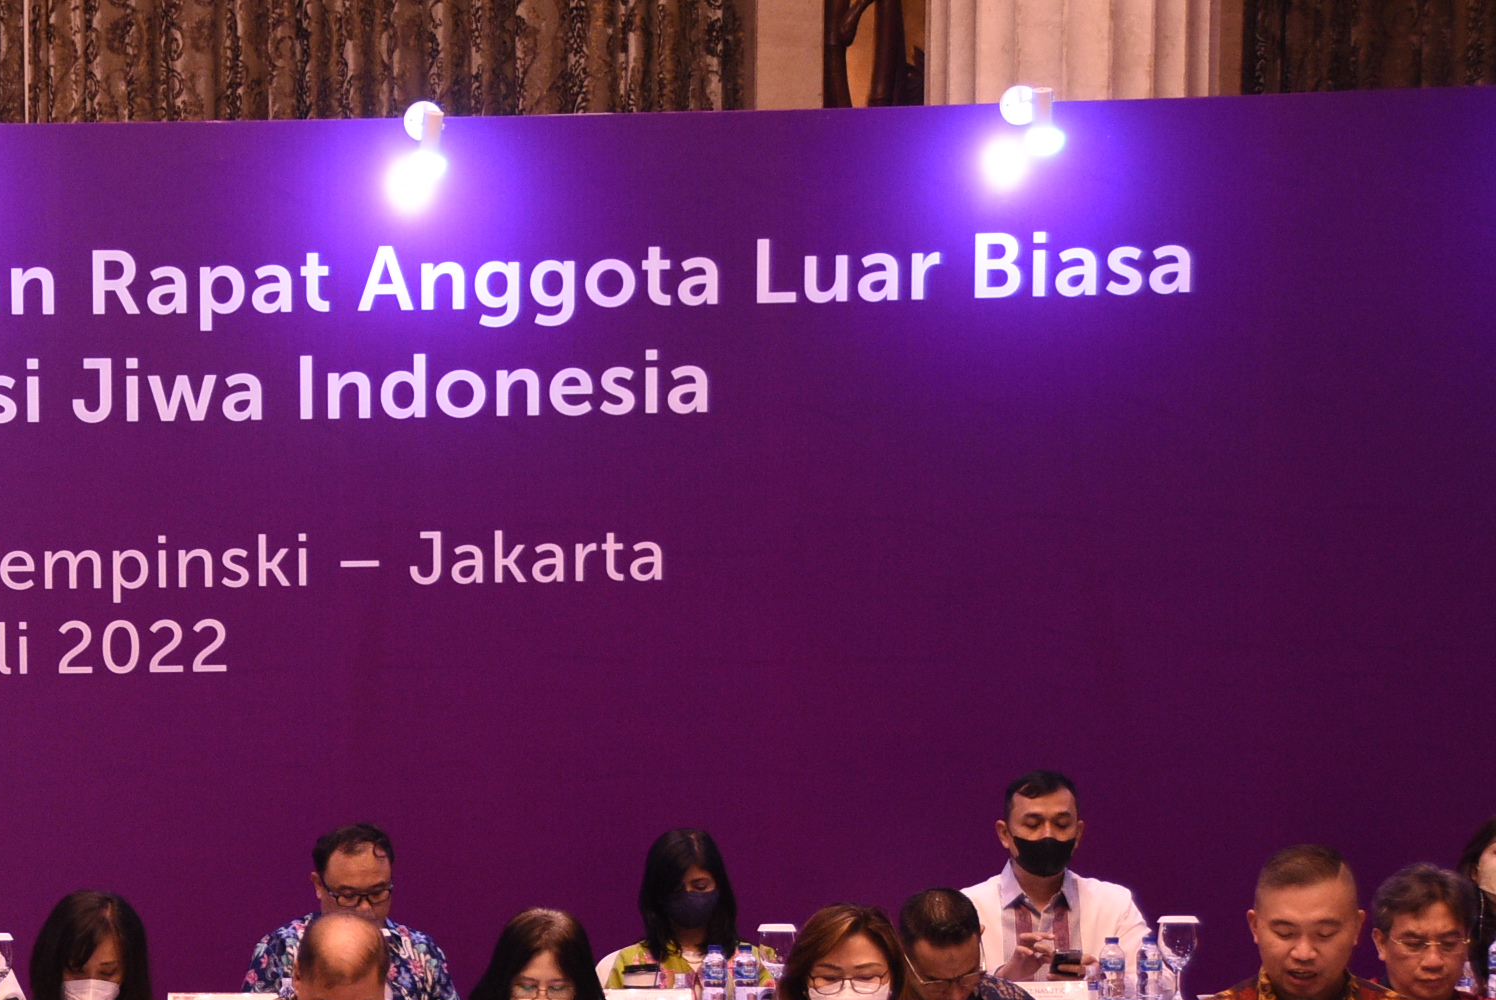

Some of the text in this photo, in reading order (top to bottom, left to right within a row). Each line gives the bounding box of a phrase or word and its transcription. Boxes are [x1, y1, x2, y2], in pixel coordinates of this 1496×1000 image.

[93, 248, 331, 332] Rapat
[359, 243, 719, 328] Anggota
[756, 238, 941, 305] Luar
[974, 231, 1192, 300] Biasa
[72, 356, 263, 424] Jiwa
[299, 348, 710, 421] Indonesia
[409, 530, 663, 586] Jakarta
[58, 618, 228, 675] 2022
